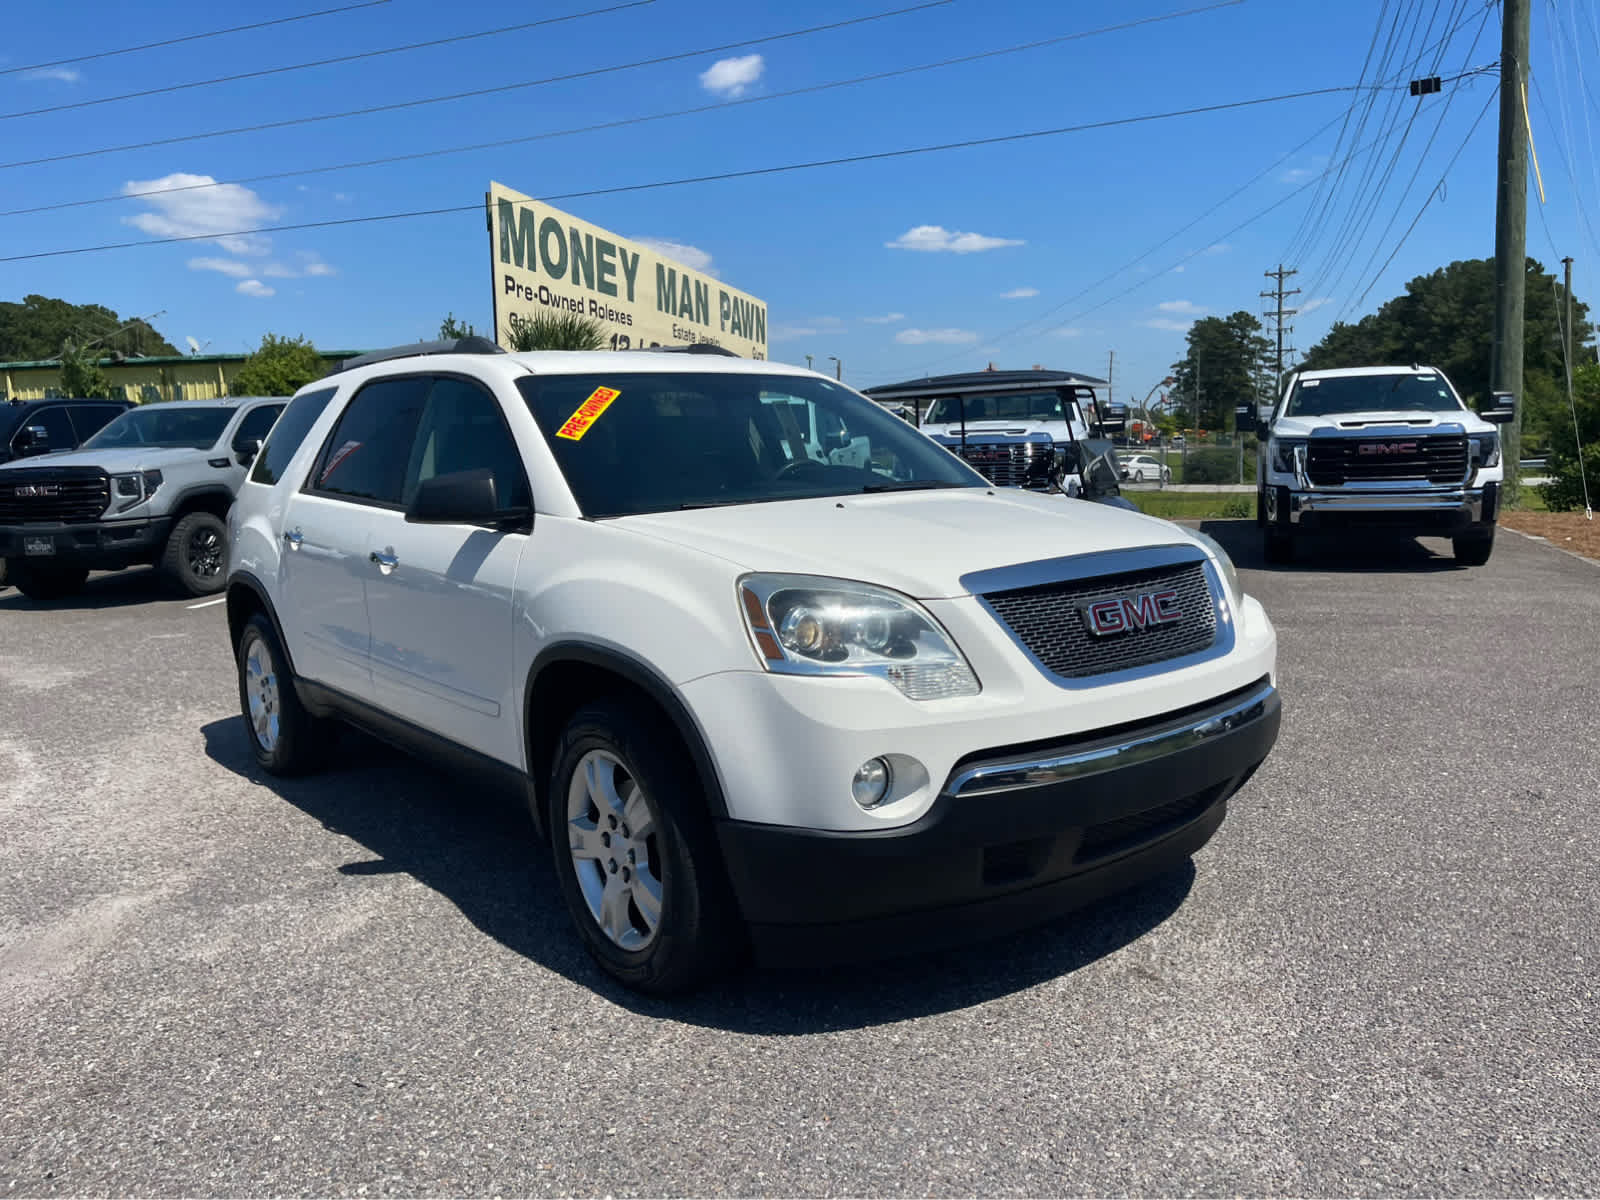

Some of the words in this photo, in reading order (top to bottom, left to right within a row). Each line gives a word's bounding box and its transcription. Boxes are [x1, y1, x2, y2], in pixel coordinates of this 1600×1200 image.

[498, 196, 640, 303] MONEY
[656, 262, 710, 326] MAN
[720, 289, 766, 344] PAWN
[504, 274, 585, 315] Pre-Owned
[589, 298, 633, 326] Rolexes
[672, 323, 697, 344] Estate
[560, 388, 614, 438] PRE-OWNED
[1359, 443, 1417, 455] GMC
[1088, 589, 1182, 636] GMC
